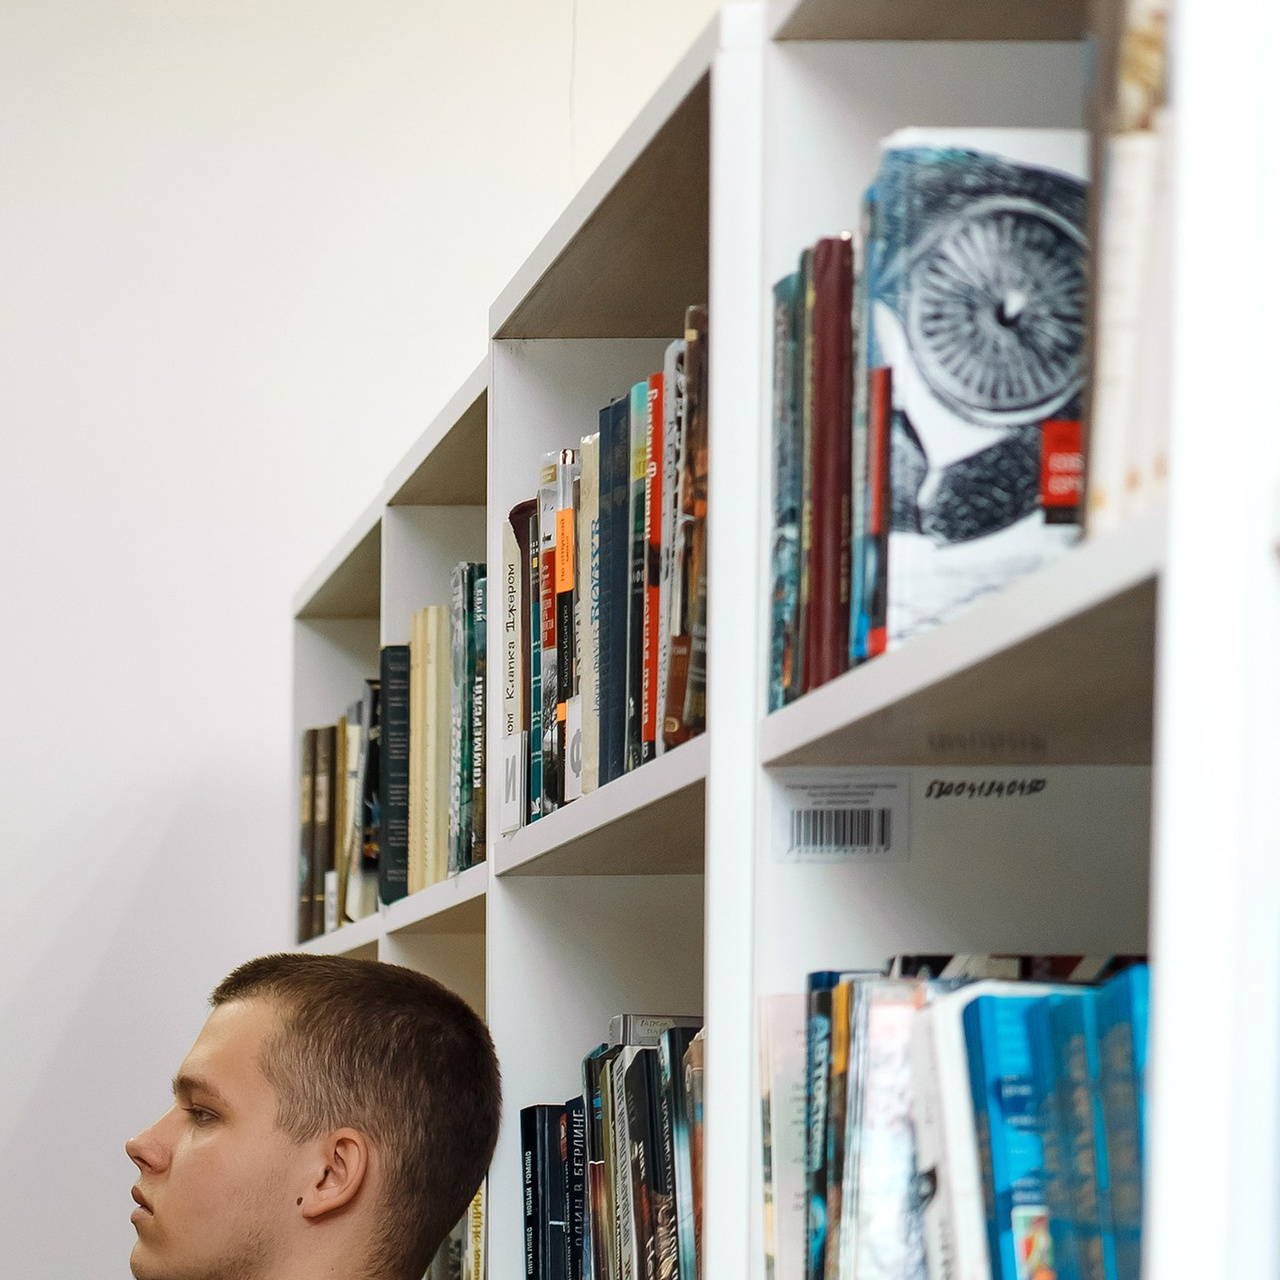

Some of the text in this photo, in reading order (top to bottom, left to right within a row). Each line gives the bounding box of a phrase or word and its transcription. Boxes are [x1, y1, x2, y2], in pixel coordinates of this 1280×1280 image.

[505, 563, 517, 633] Джером
[505, 640, 515, 700] Клапка
[473, 676, 484, 789] КОММЕРСАНТ
[572, 1108, 584, 1177] БЕРЛИНЕ
